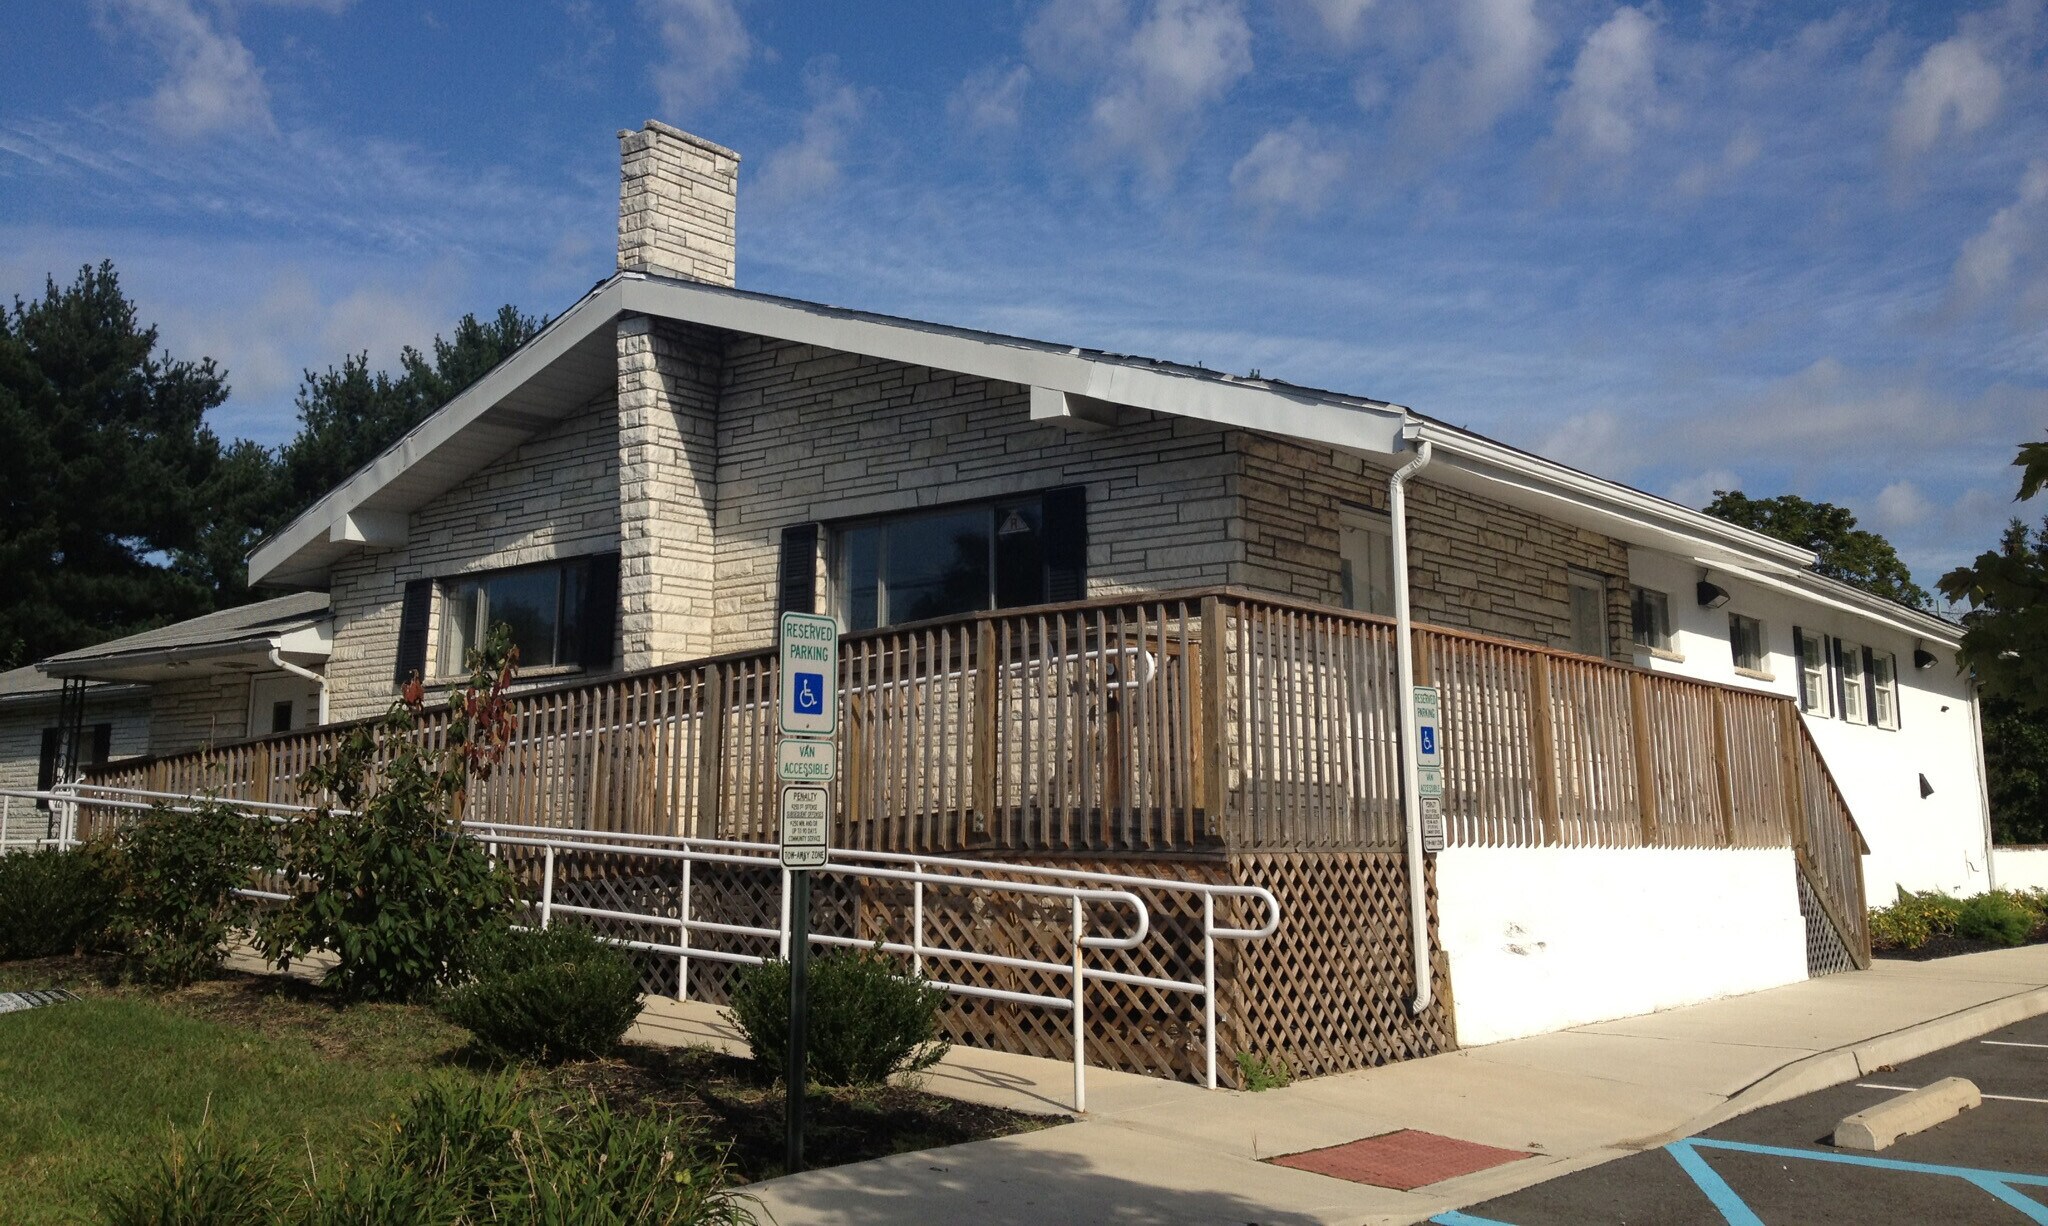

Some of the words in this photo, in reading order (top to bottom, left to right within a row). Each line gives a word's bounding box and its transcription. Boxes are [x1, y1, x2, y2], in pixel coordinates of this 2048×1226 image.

[786, 622, 833, 642] RESERVED
[790, 644, 829, 662] PARKING
[1415, 693, 1436, 705] RESERVED
[1417, 708, 1435, 719] PARKING
[799, 746, 815, 758] VAN
[784, 762, 830, 775] ACCESSIBLE
[793, 792, 818, 802] PENALTY
[811, 850, 825, 859] ZONE
